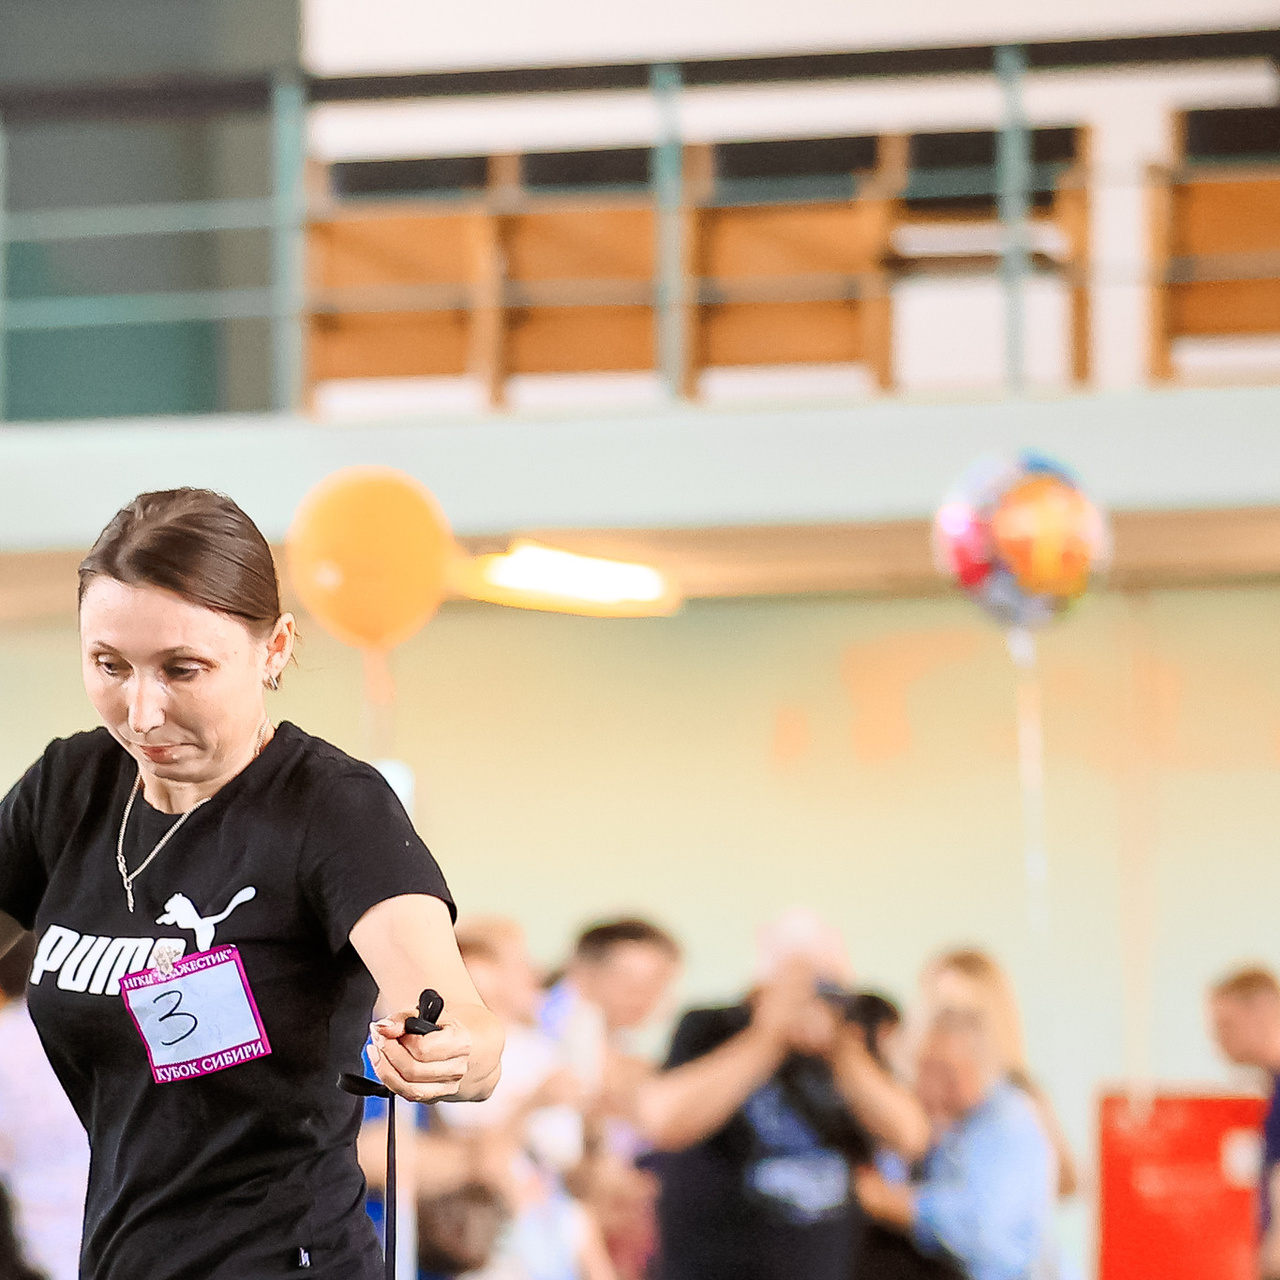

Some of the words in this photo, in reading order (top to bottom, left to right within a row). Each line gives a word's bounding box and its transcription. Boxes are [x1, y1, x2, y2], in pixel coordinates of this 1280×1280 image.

[153, 989, 198, 1046] 3
[155, 1062, 201, 1082] КУБОК
[201, 1040, 265, 1072] СИБИРИ
